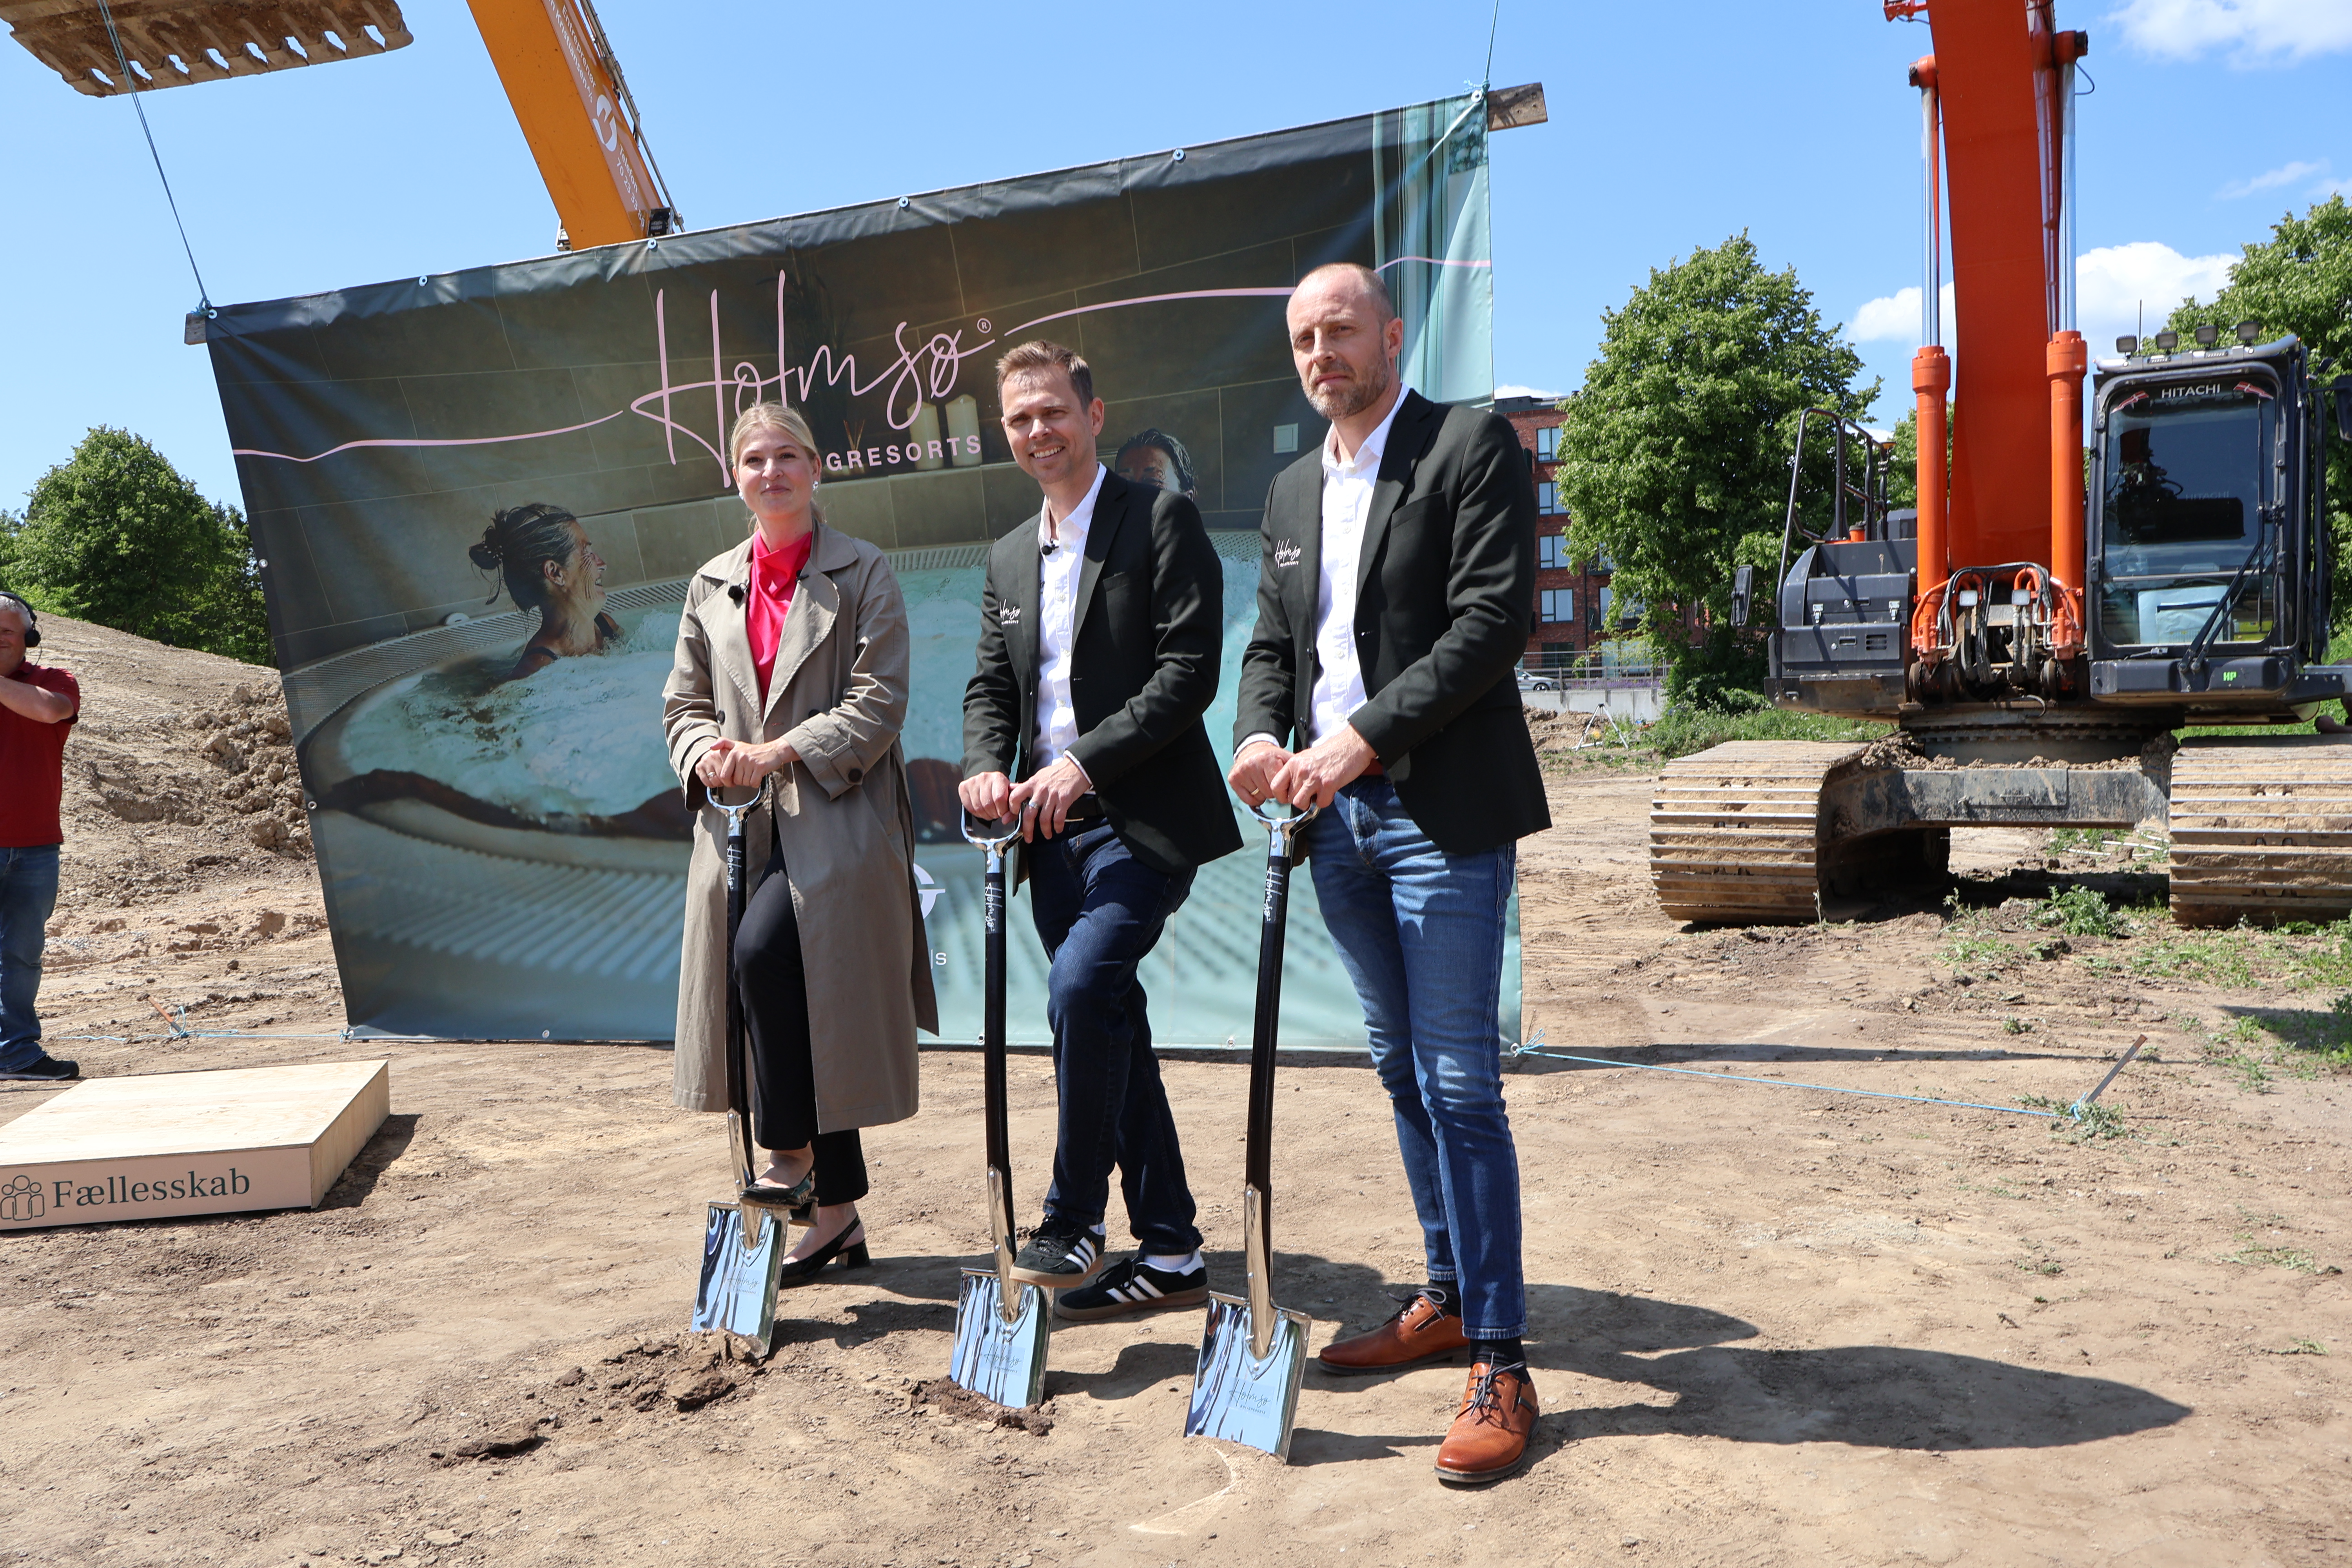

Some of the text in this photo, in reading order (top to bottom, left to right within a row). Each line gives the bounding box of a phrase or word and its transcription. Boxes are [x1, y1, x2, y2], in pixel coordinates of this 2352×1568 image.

[556, 9, 587, 88] Kristiansen
[563, 5, 596, 88] Entreprenør
[620, 144, 638, 193] Telefon
[631, 192, 638, 211] 33
[2161, 383, 2221, 399] HITACHI
[826, 435, 981, 472] GRESORTS
[2223, 671, 2237, 681] HP
[52, 1167, 251, 1208] Fællesskab
